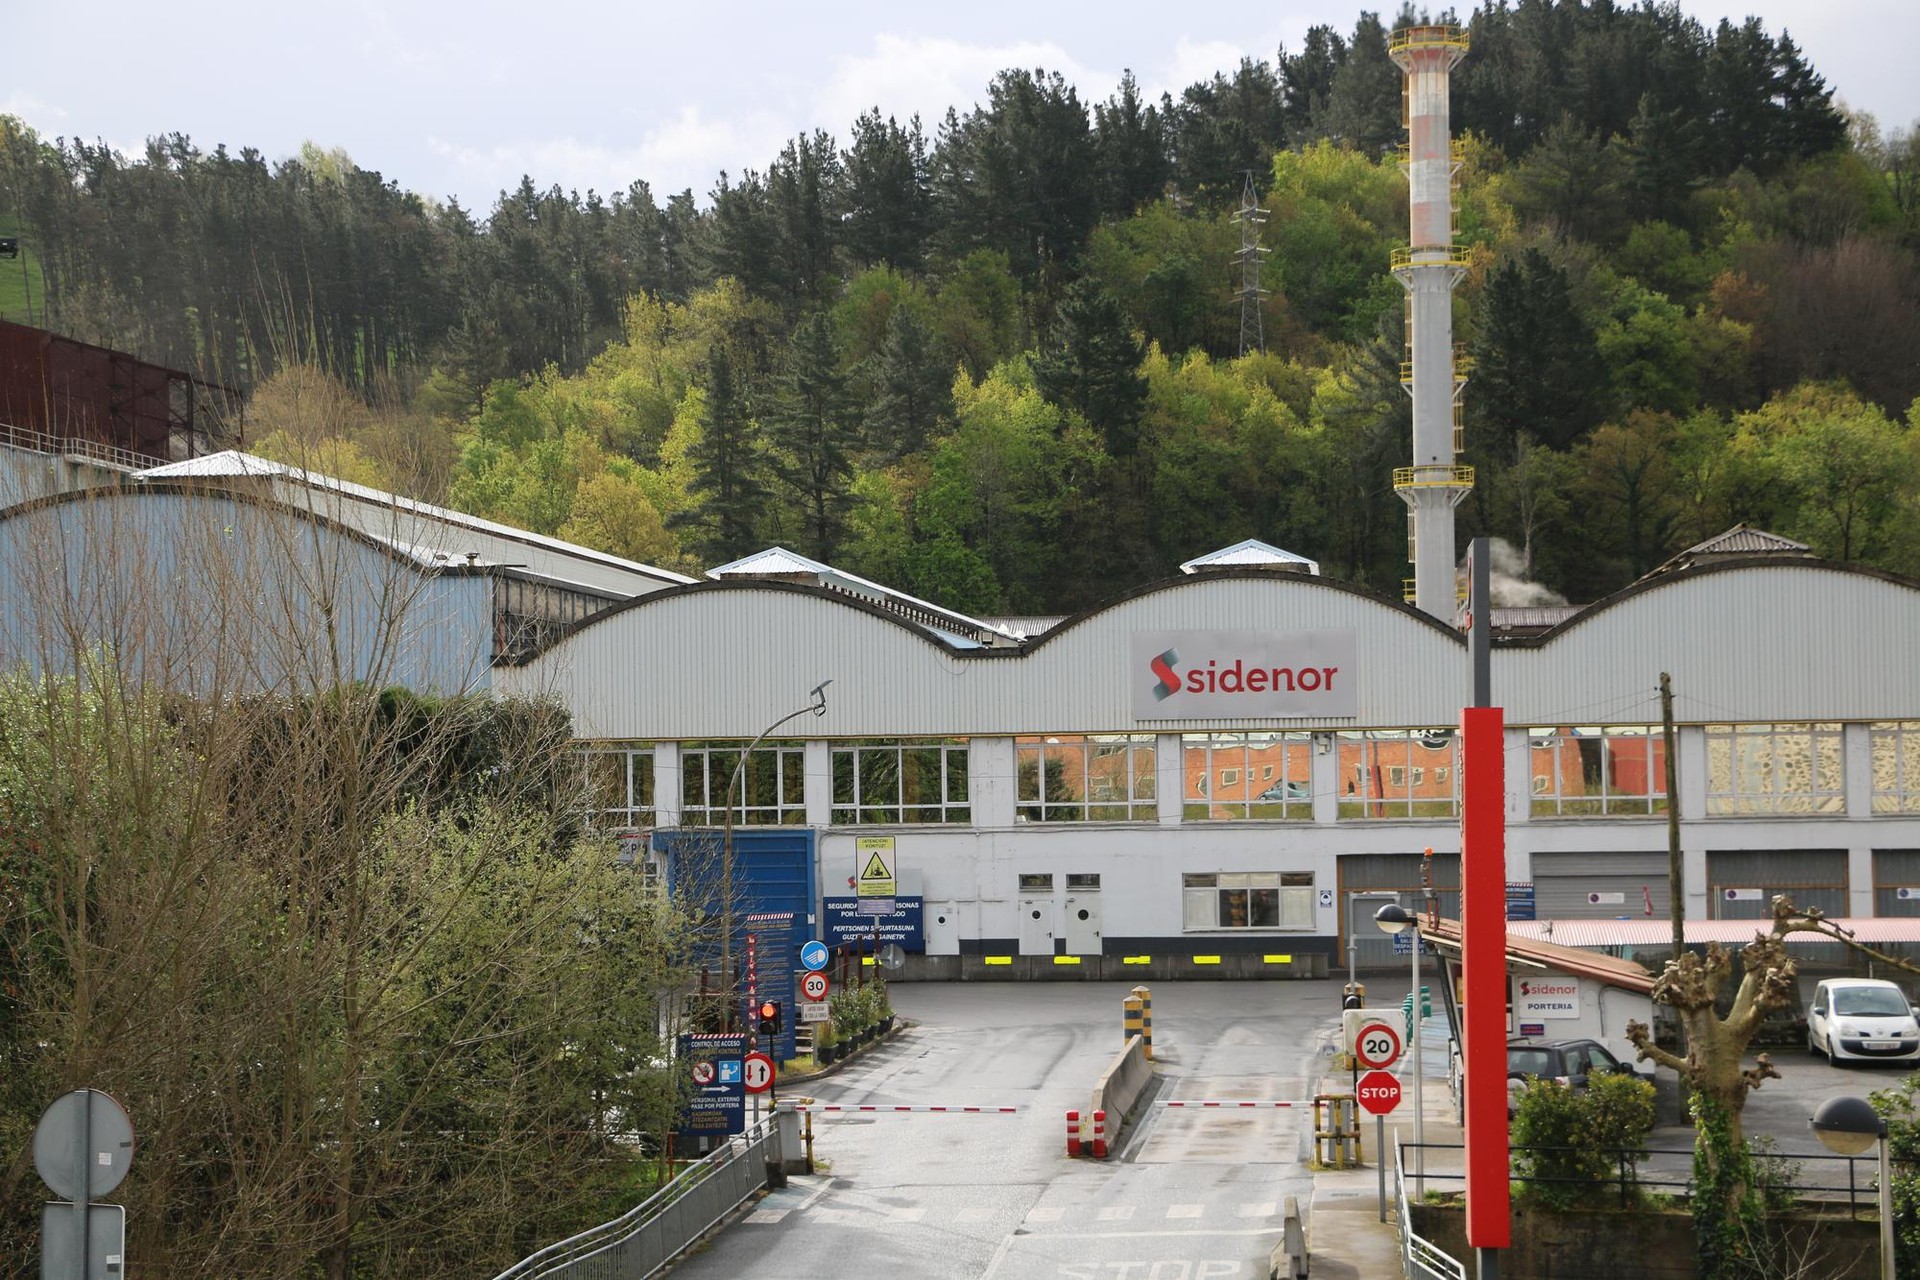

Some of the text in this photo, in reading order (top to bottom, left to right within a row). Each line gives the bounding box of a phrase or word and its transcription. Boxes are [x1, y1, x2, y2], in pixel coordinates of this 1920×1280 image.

[1186, 659, 1338, 693] sidenor
[807, 981, 823, 991] 30
[1531, 984, 1577, 994] sidenor
[1366, 1039, 1390, 1054] 20
[1361, 1088, 1398, 1098] STOP
